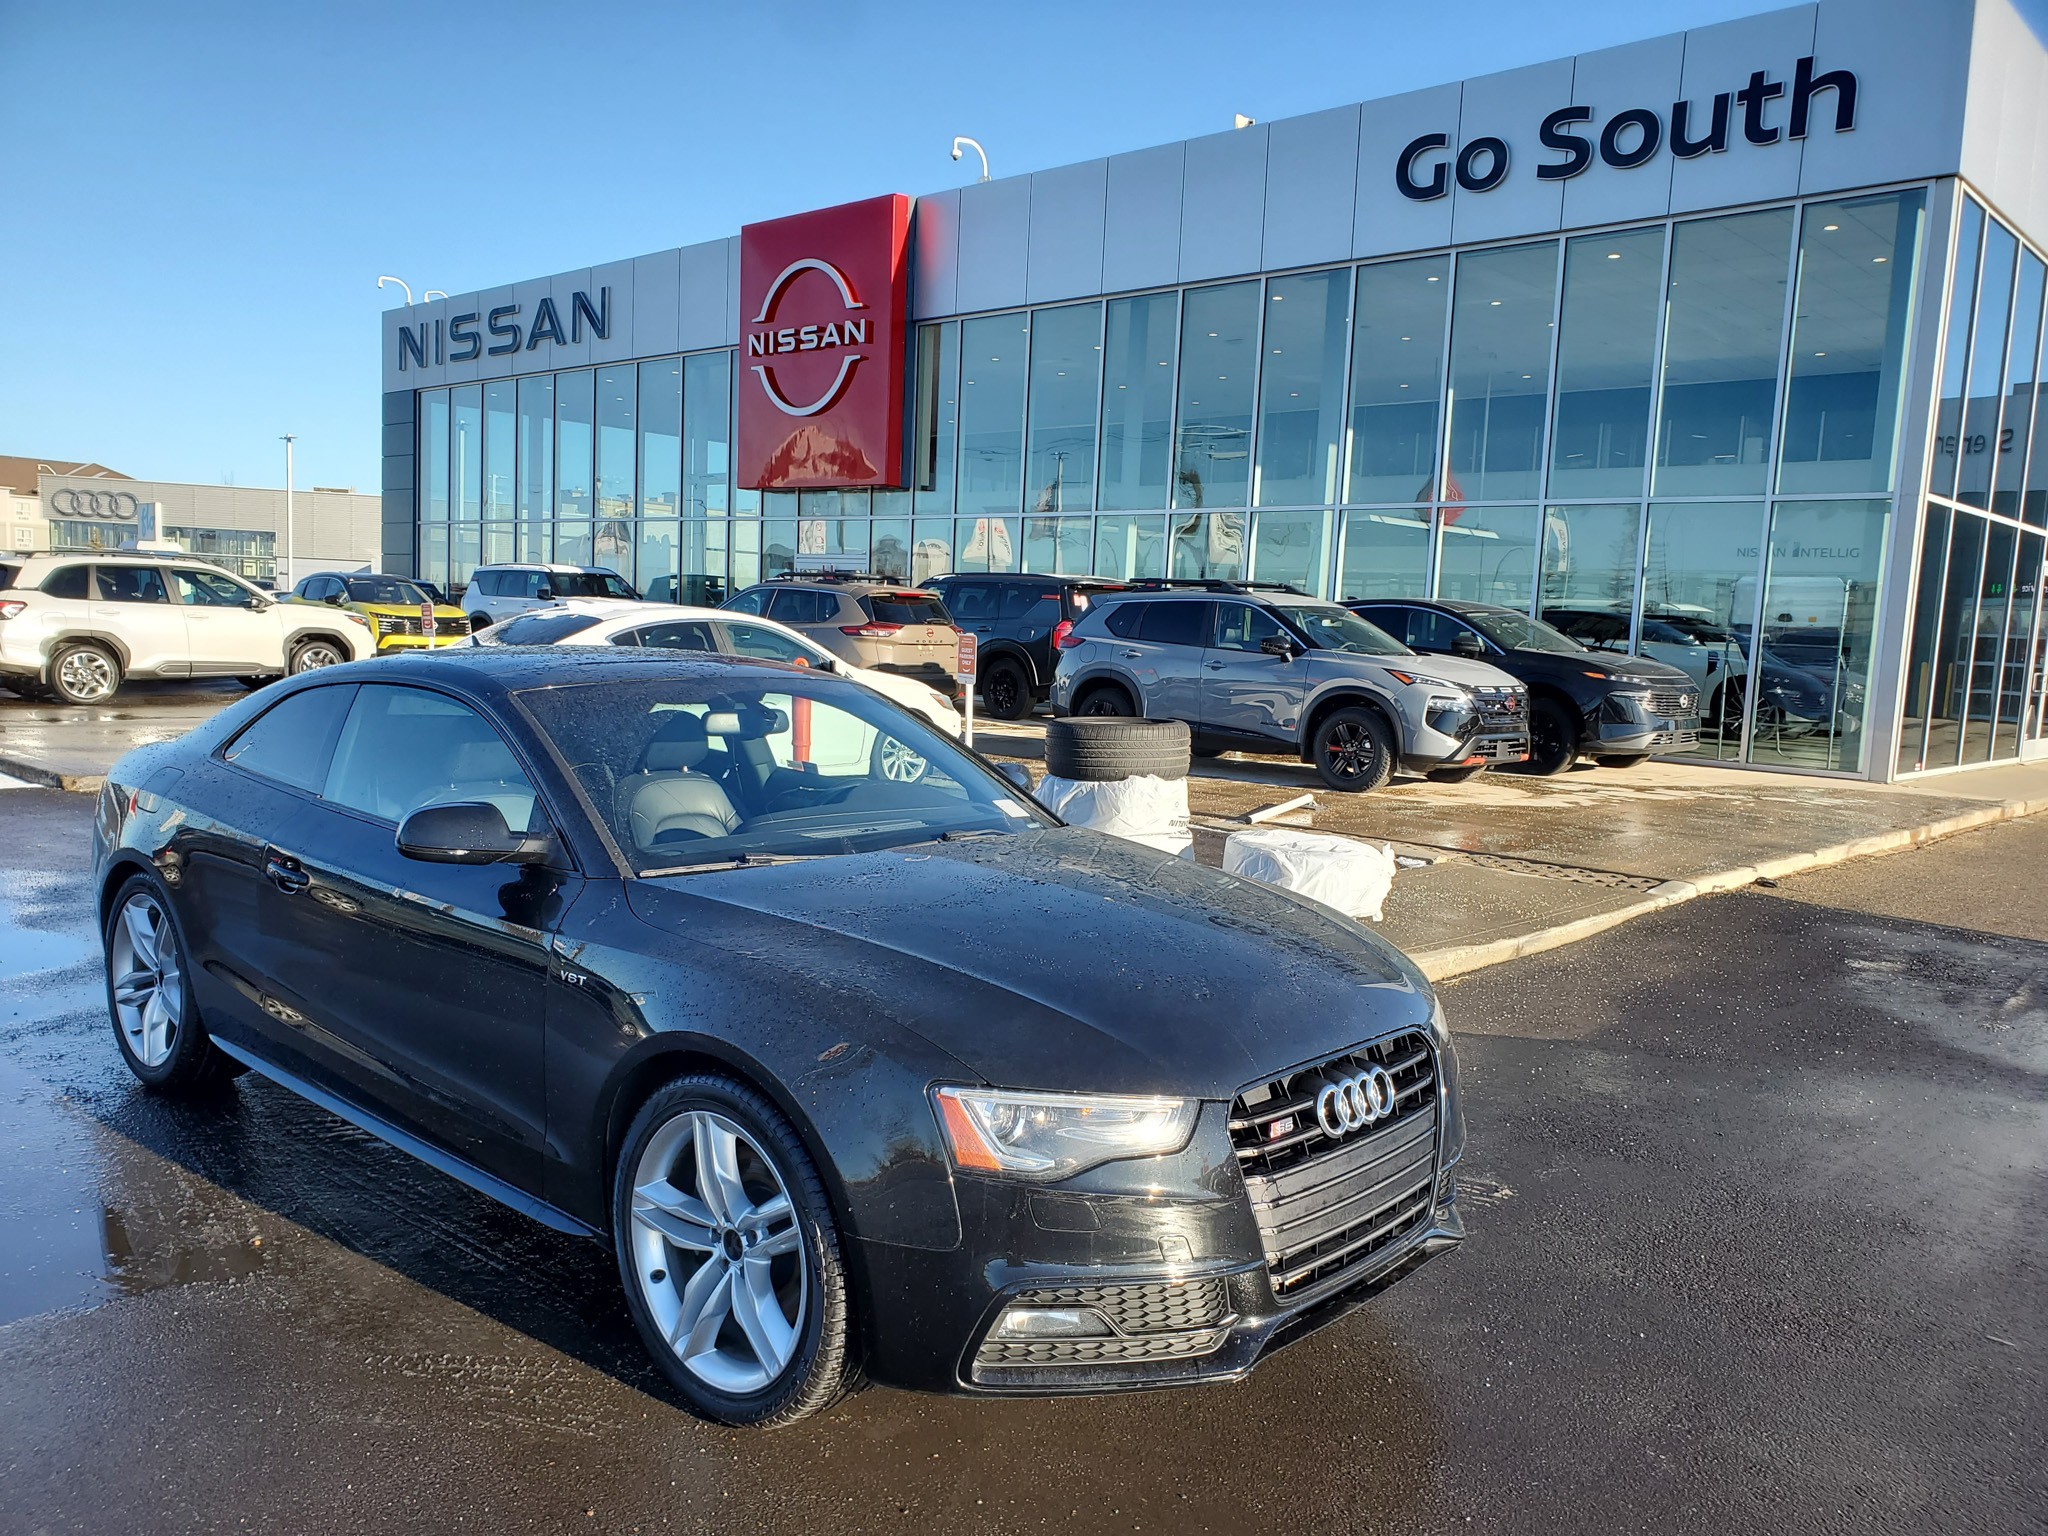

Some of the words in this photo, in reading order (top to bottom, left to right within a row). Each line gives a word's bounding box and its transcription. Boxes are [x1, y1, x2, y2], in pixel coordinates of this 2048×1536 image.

[1395, 132, 1509, 201] Go
[1536, 55, 1859, 180] South
[398, 286, 610, 371] NISSAN
[748, 318, 866, 356] NISSAN
